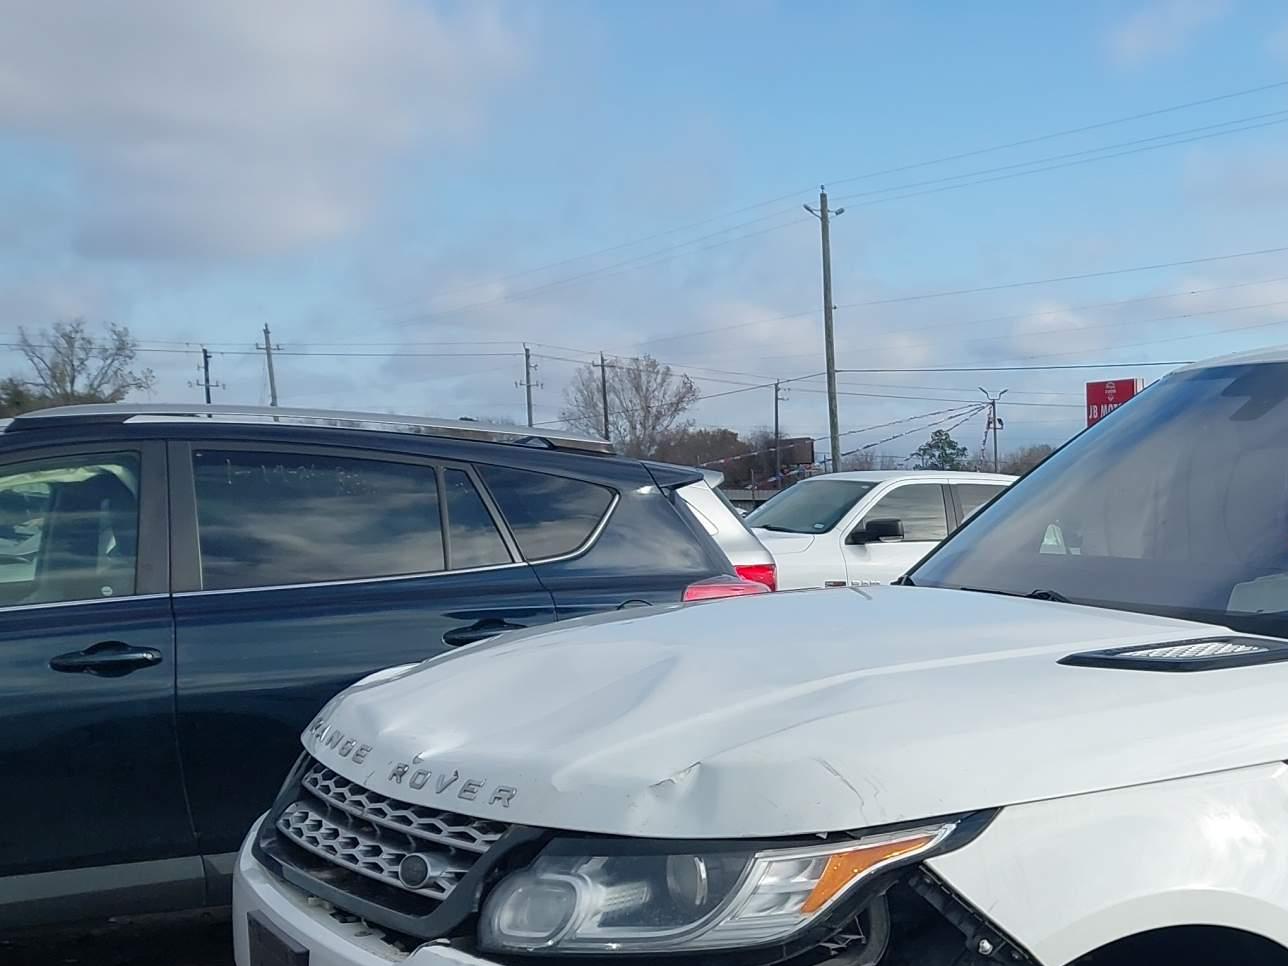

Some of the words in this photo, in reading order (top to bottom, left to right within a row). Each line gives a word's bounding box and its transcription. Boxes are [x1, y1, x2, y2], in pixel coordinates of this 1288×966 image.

[1089, 404, 1098, 419] JB
[1101, 403, 1122, 418] MO
[309, 717, 373, 765] RANGE
[388, 762, 518, 808] ROVER
